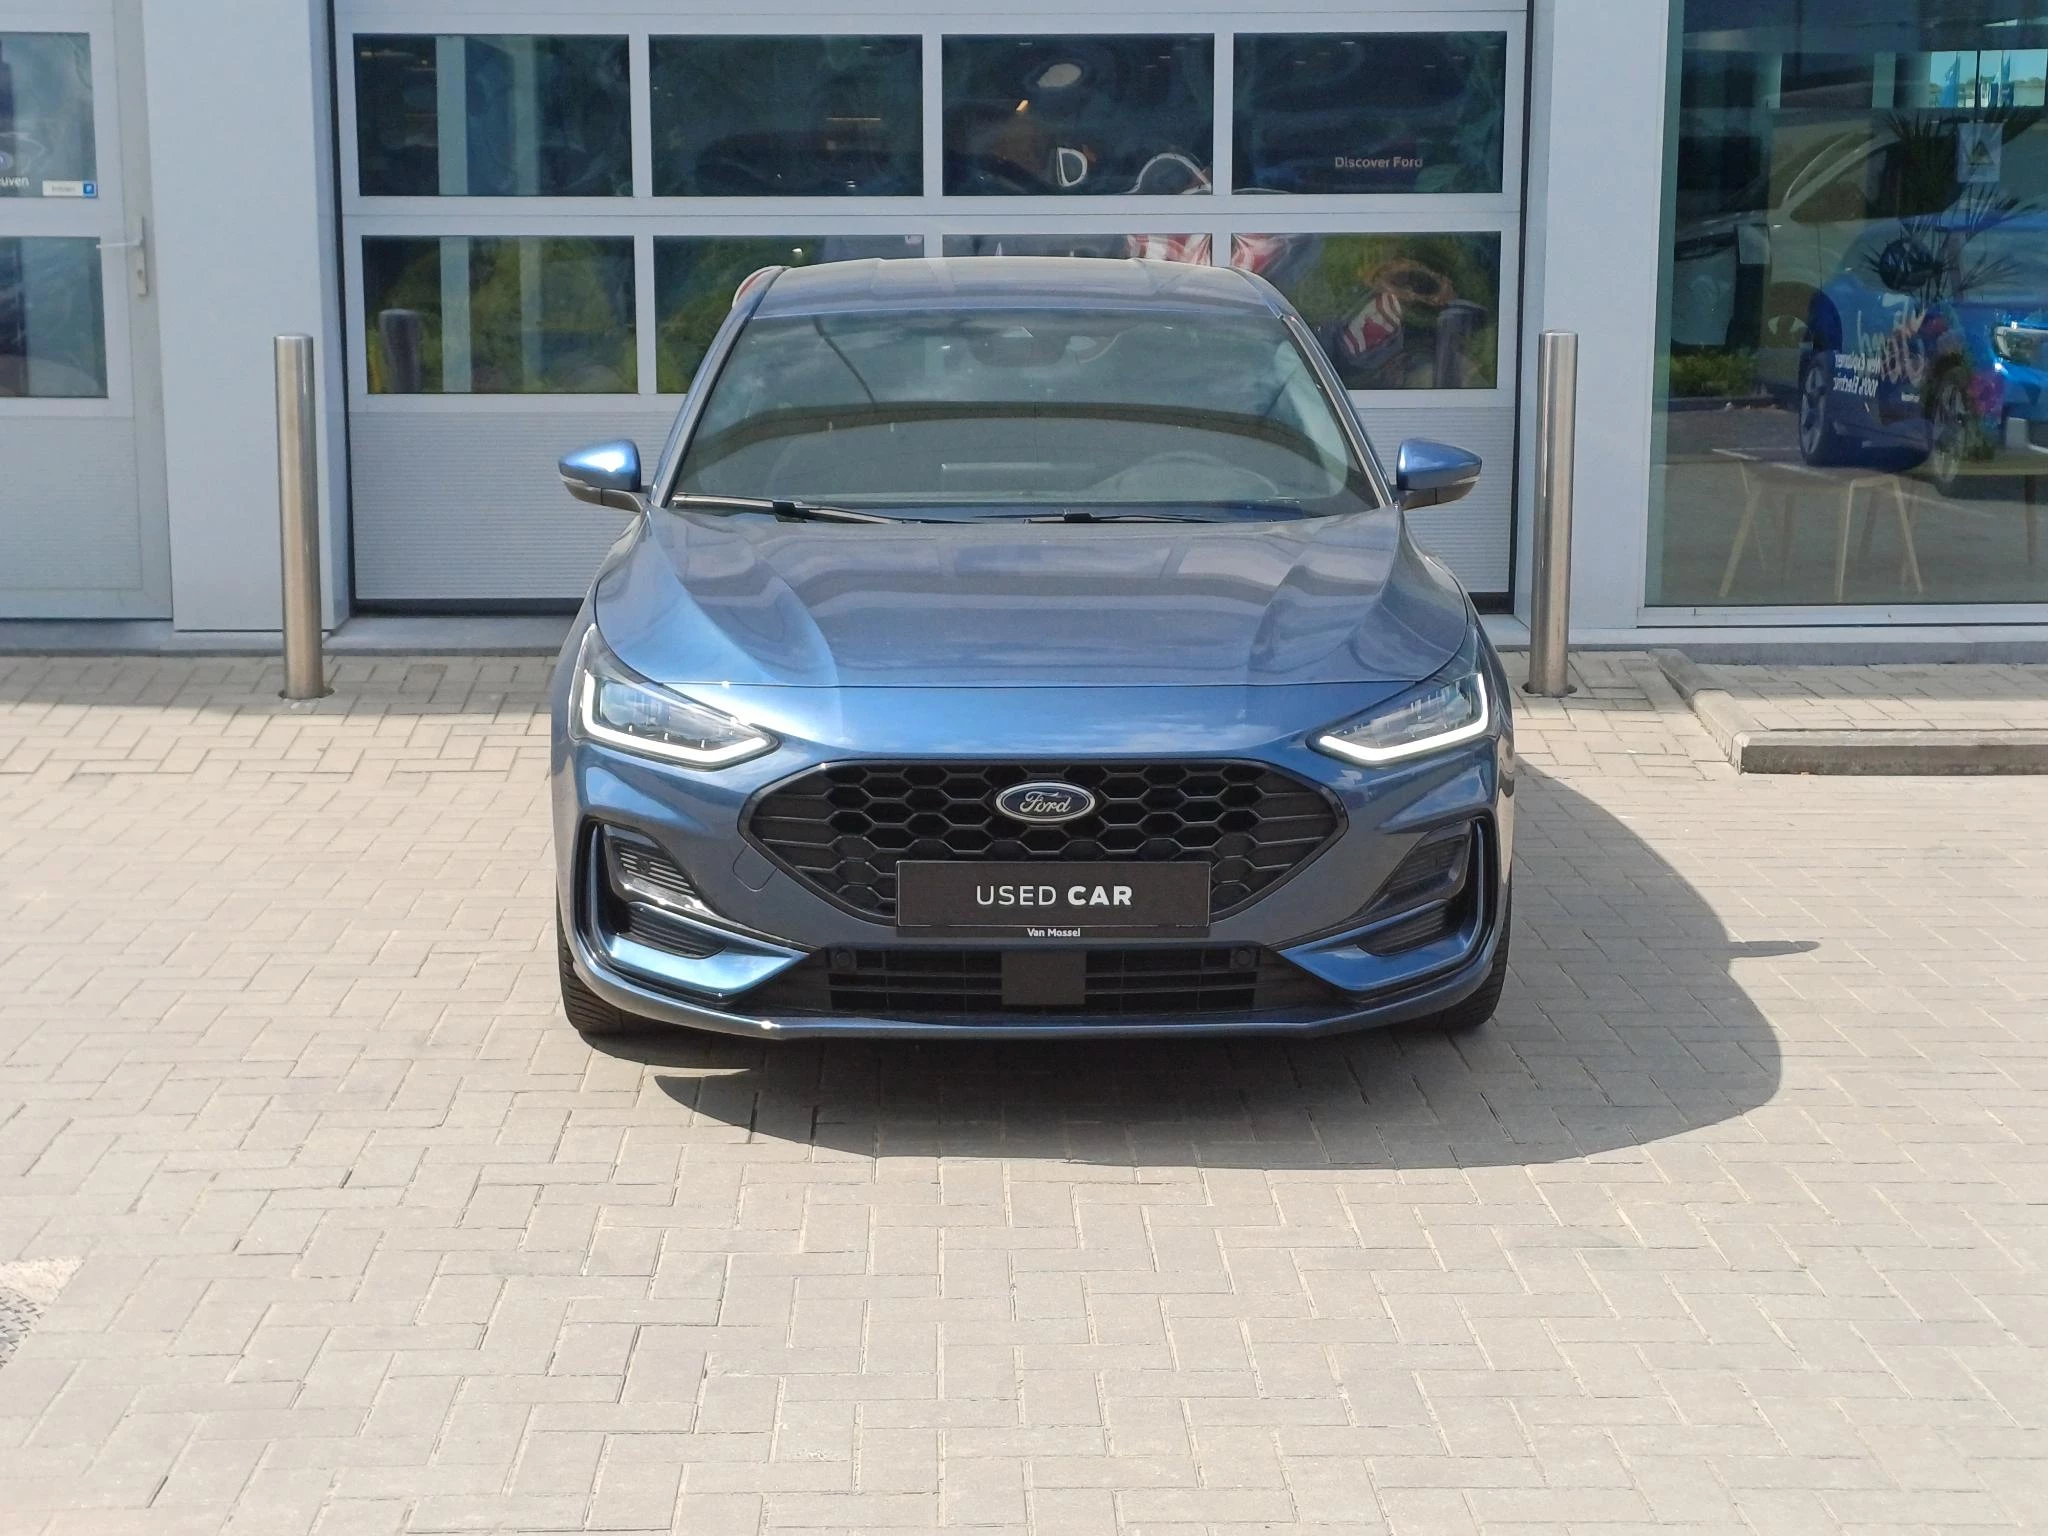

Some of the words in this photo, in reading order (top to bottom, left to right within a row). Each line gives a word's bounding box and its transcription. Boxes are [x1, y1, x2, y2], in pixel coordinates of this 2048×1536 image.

[1335, 156, 1390, 168] Discover
[1393, 156, 1423, 168] Ford
[0, 176, 30, 188] uven
[1020, 791, 1072, 813] Ford
[976, 885, 1057, 906] USED
[1067, 885, 1133, 906] CAR
[1027, 928, 1045, 937] Van
[1048, 928, 1081, 937] Mossel
